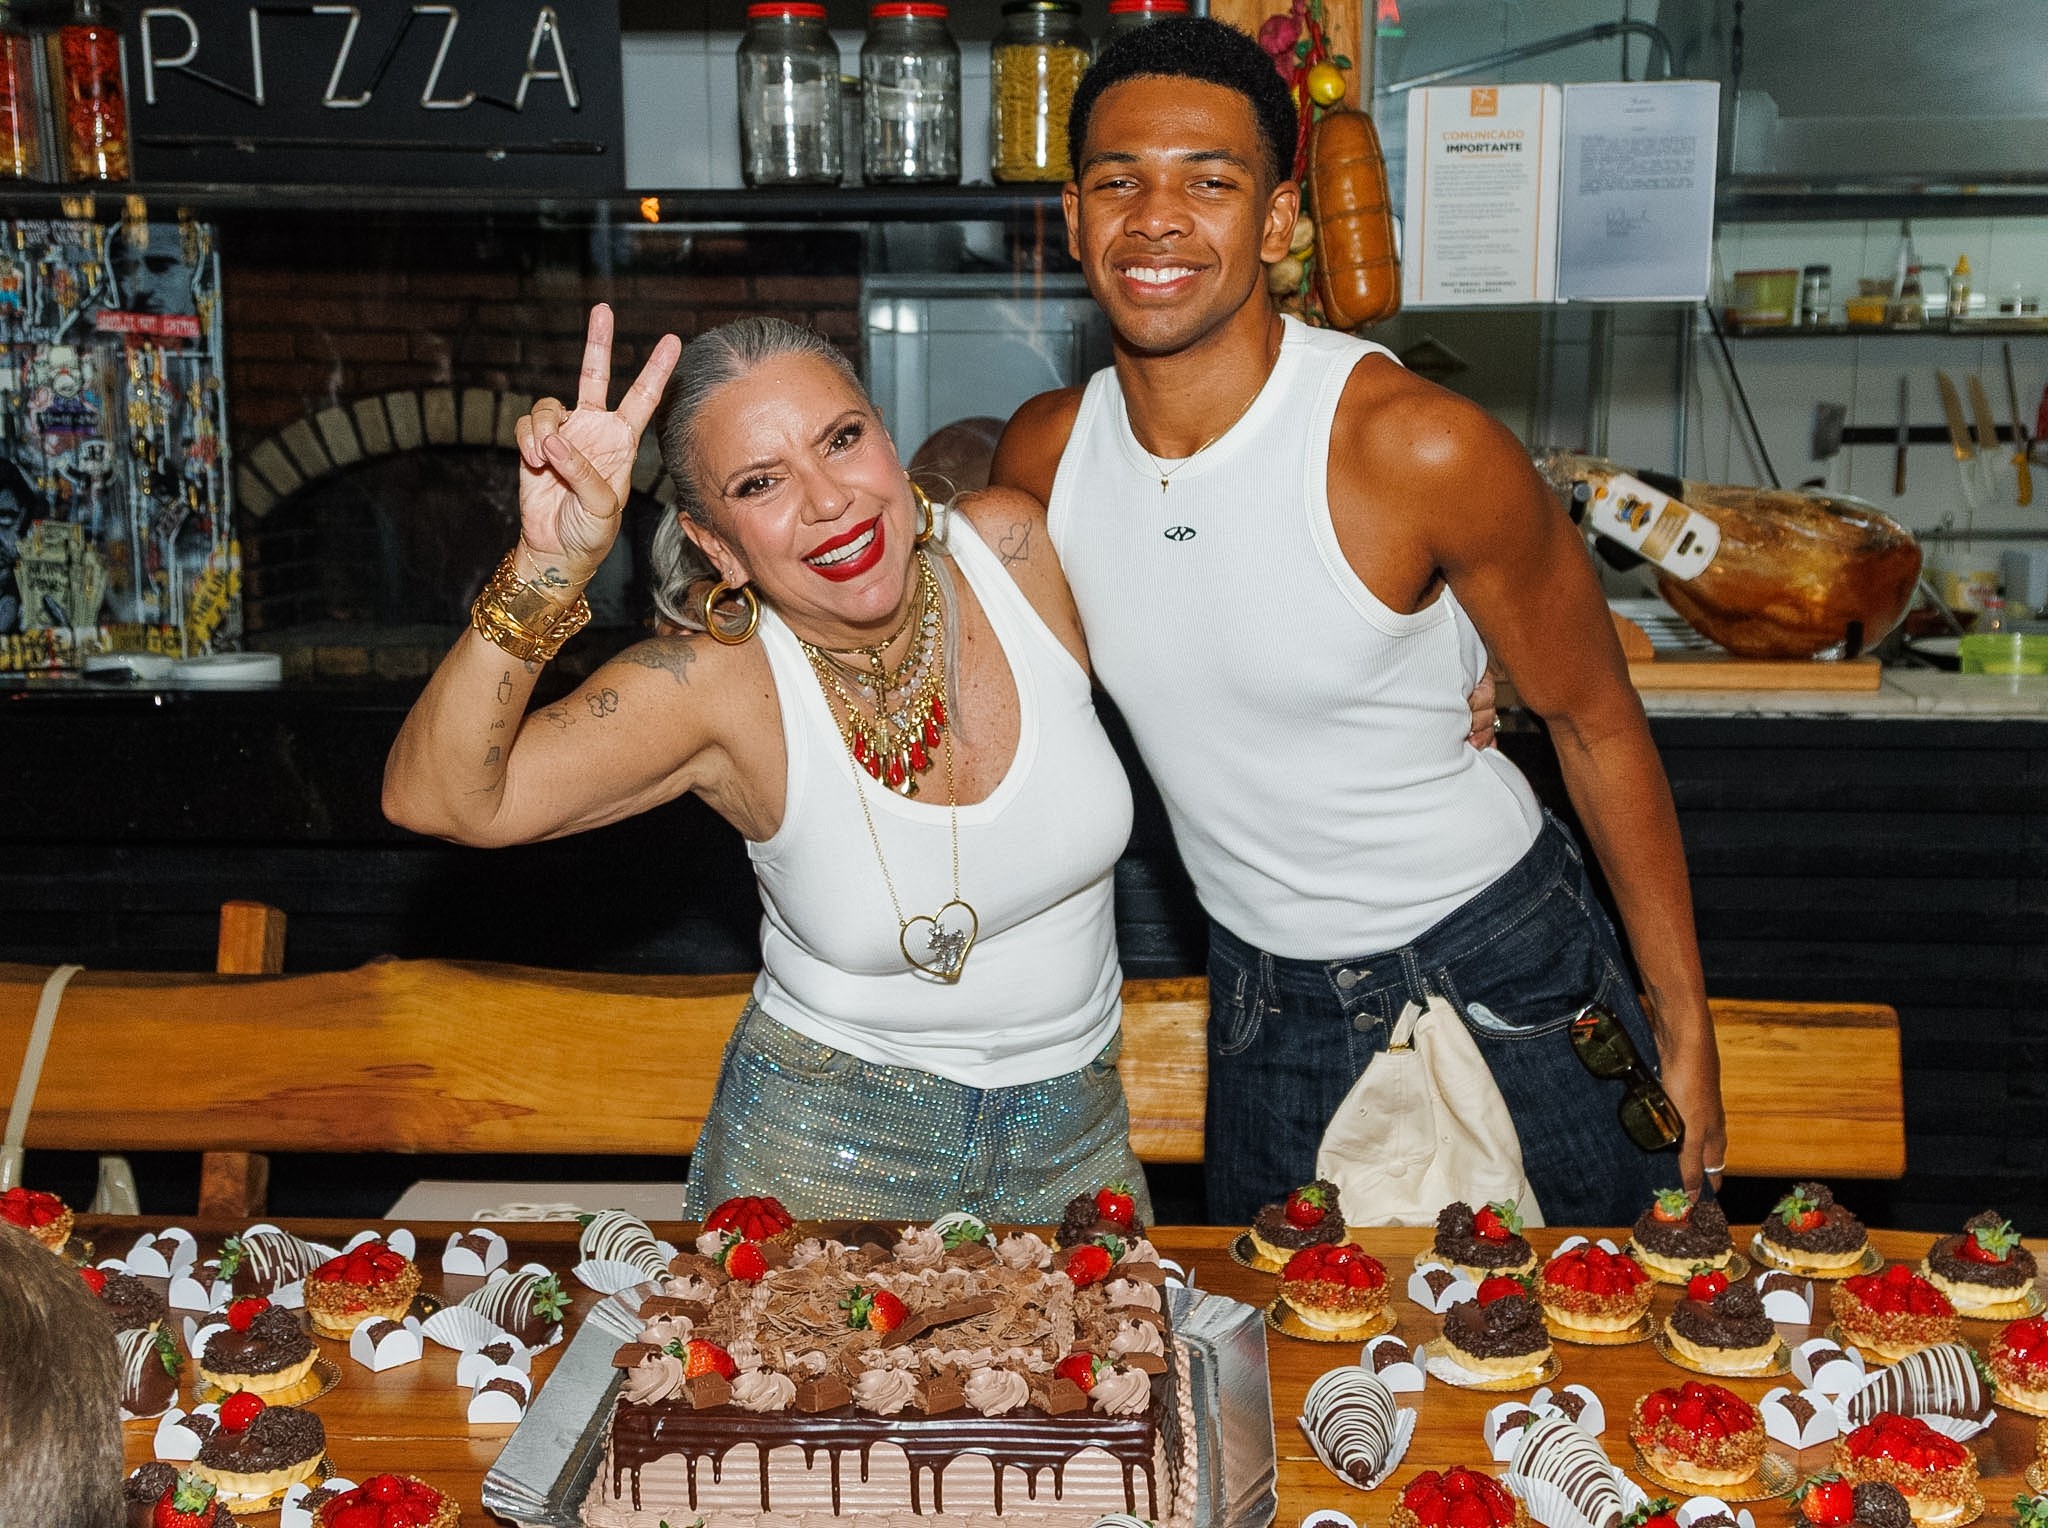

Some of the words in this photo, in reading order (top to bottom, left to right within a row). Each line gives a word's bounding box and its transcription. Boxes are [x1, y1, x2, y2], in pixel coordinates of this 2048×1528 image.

[142, 5, 580, 109] PIZZA
[1442, 130, 1525, 141] COMUNICADO
[1446, 142, 1523, 153] IMPORTANTE
